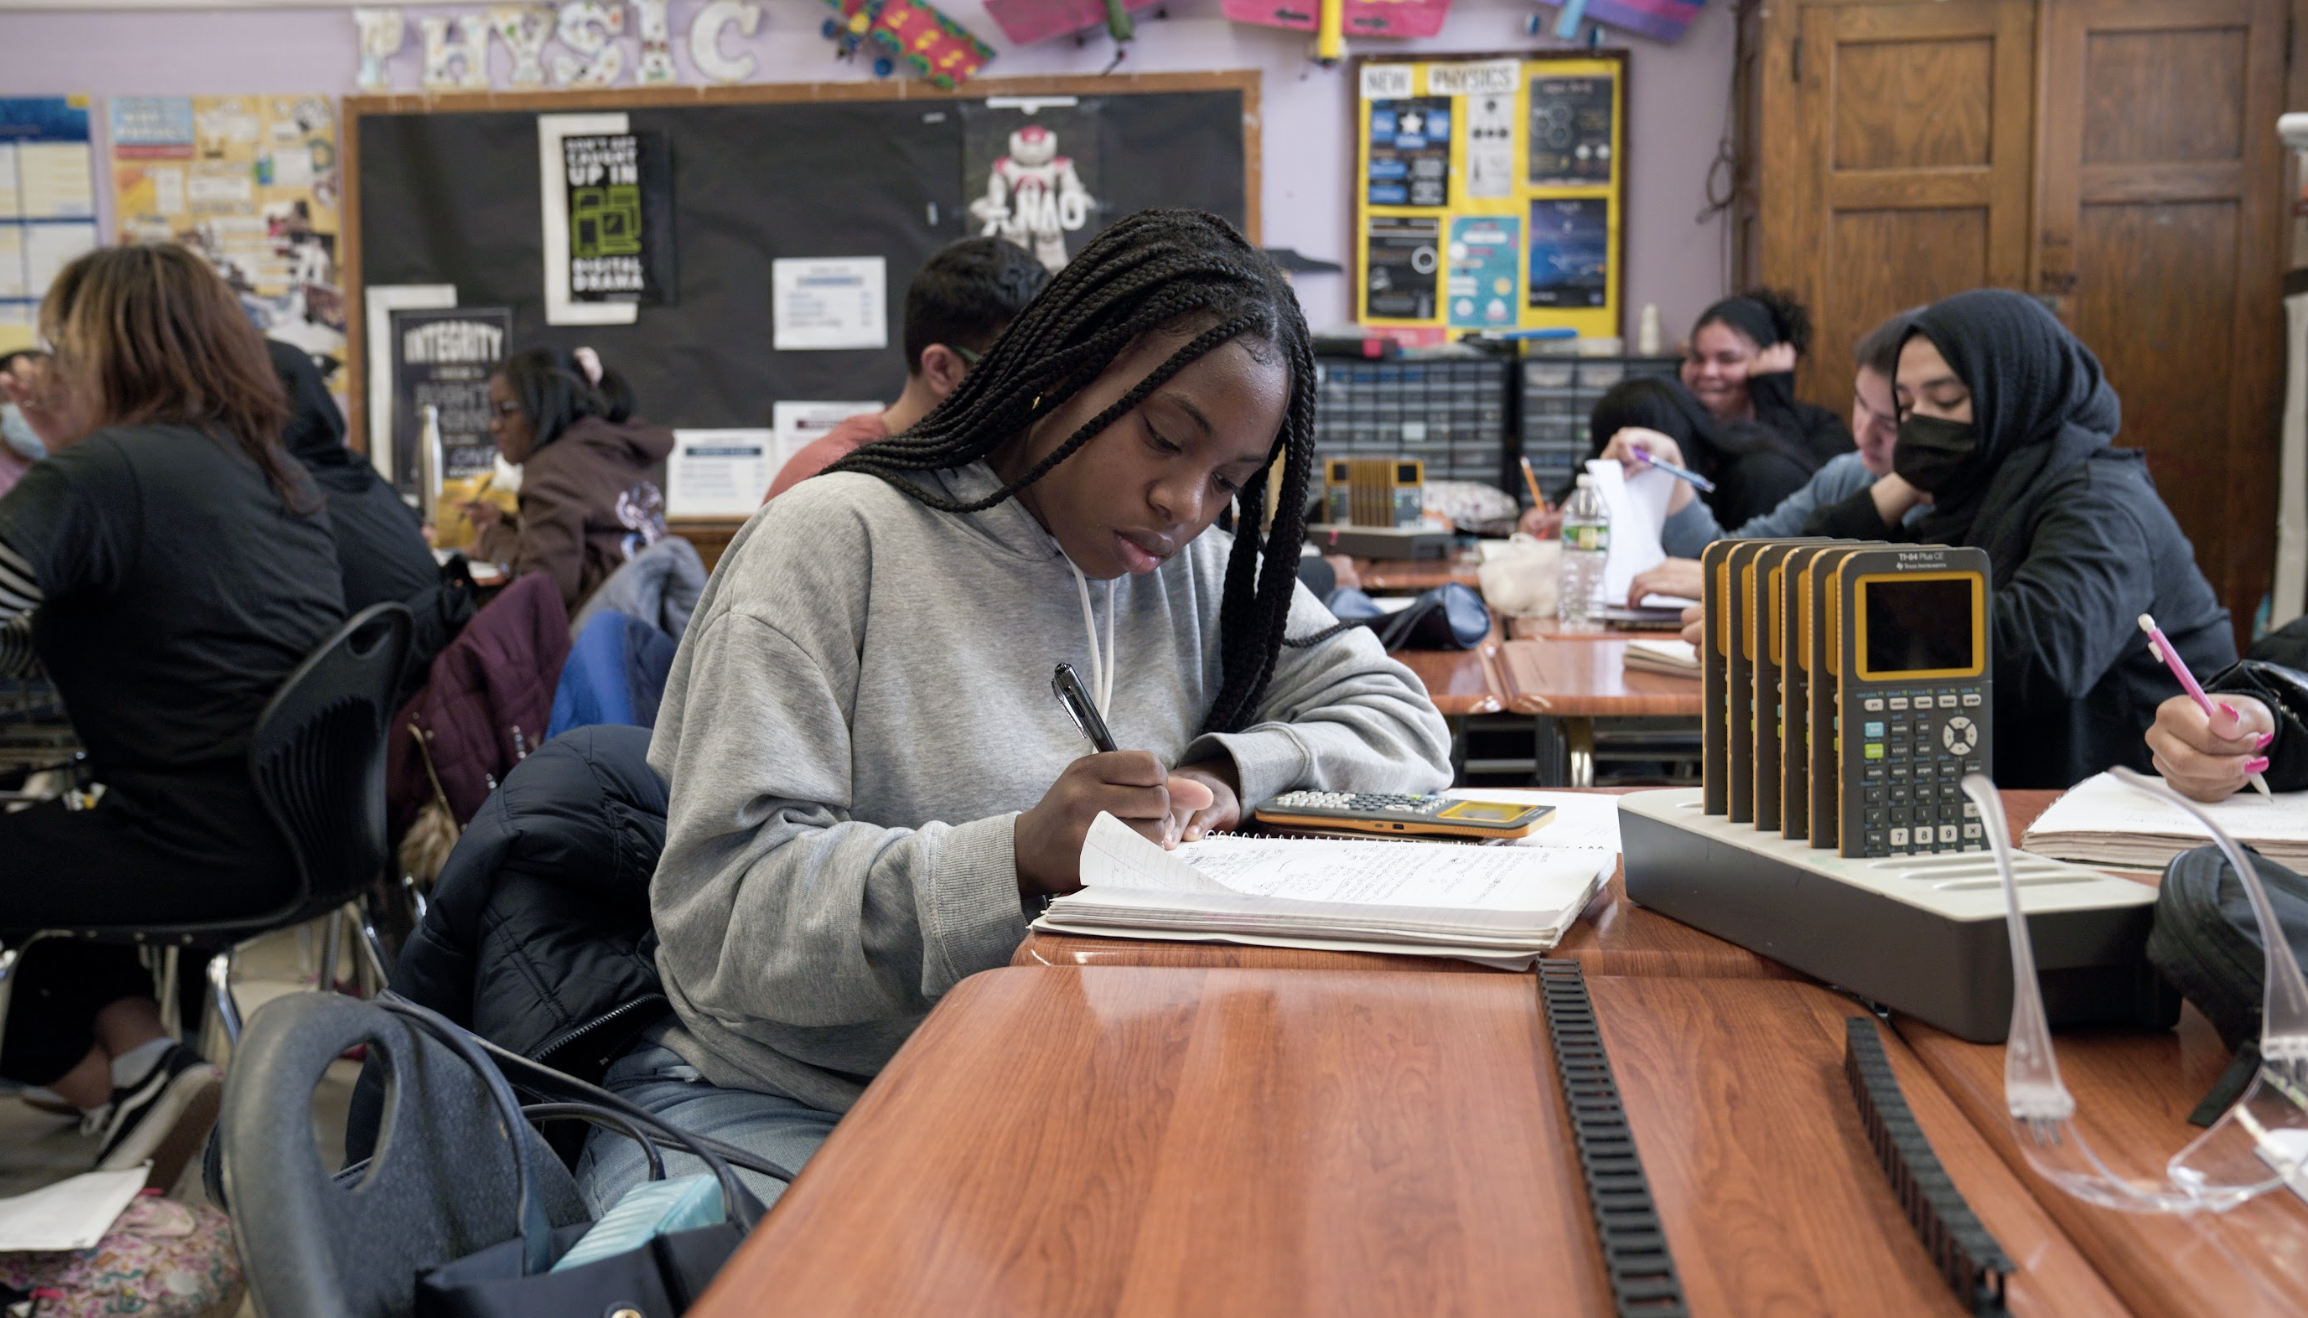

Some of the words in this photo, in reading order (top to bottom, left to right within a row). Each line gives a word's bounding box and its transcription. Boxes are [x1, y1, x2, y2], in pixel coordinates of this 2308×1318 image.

[1367, 69, 1409, 94] NEW
[1431, 66, 1513, 91] PHYSICS
[609, 135, 637, 149] GET
[566, 147, 637, 167] CAUGHT
[568, 165, 604, 186] UP
[609, 164, 638, 185] IN
[572, 256, 643, 275] DIGITAL
[572, 272, 644, 292] DRAMA
[404, 320, 503, 364] INTEGRITY
[1898, 552, 1918, 561] TI-84
[1919, 552, 1933, 560] Plus
[1934, 551, 1944, 560] CE
[1897, 833, 1903, 841] 7
[1921, 831, 1928, 840] 8
[1945, 829, 1952, 838] 9
